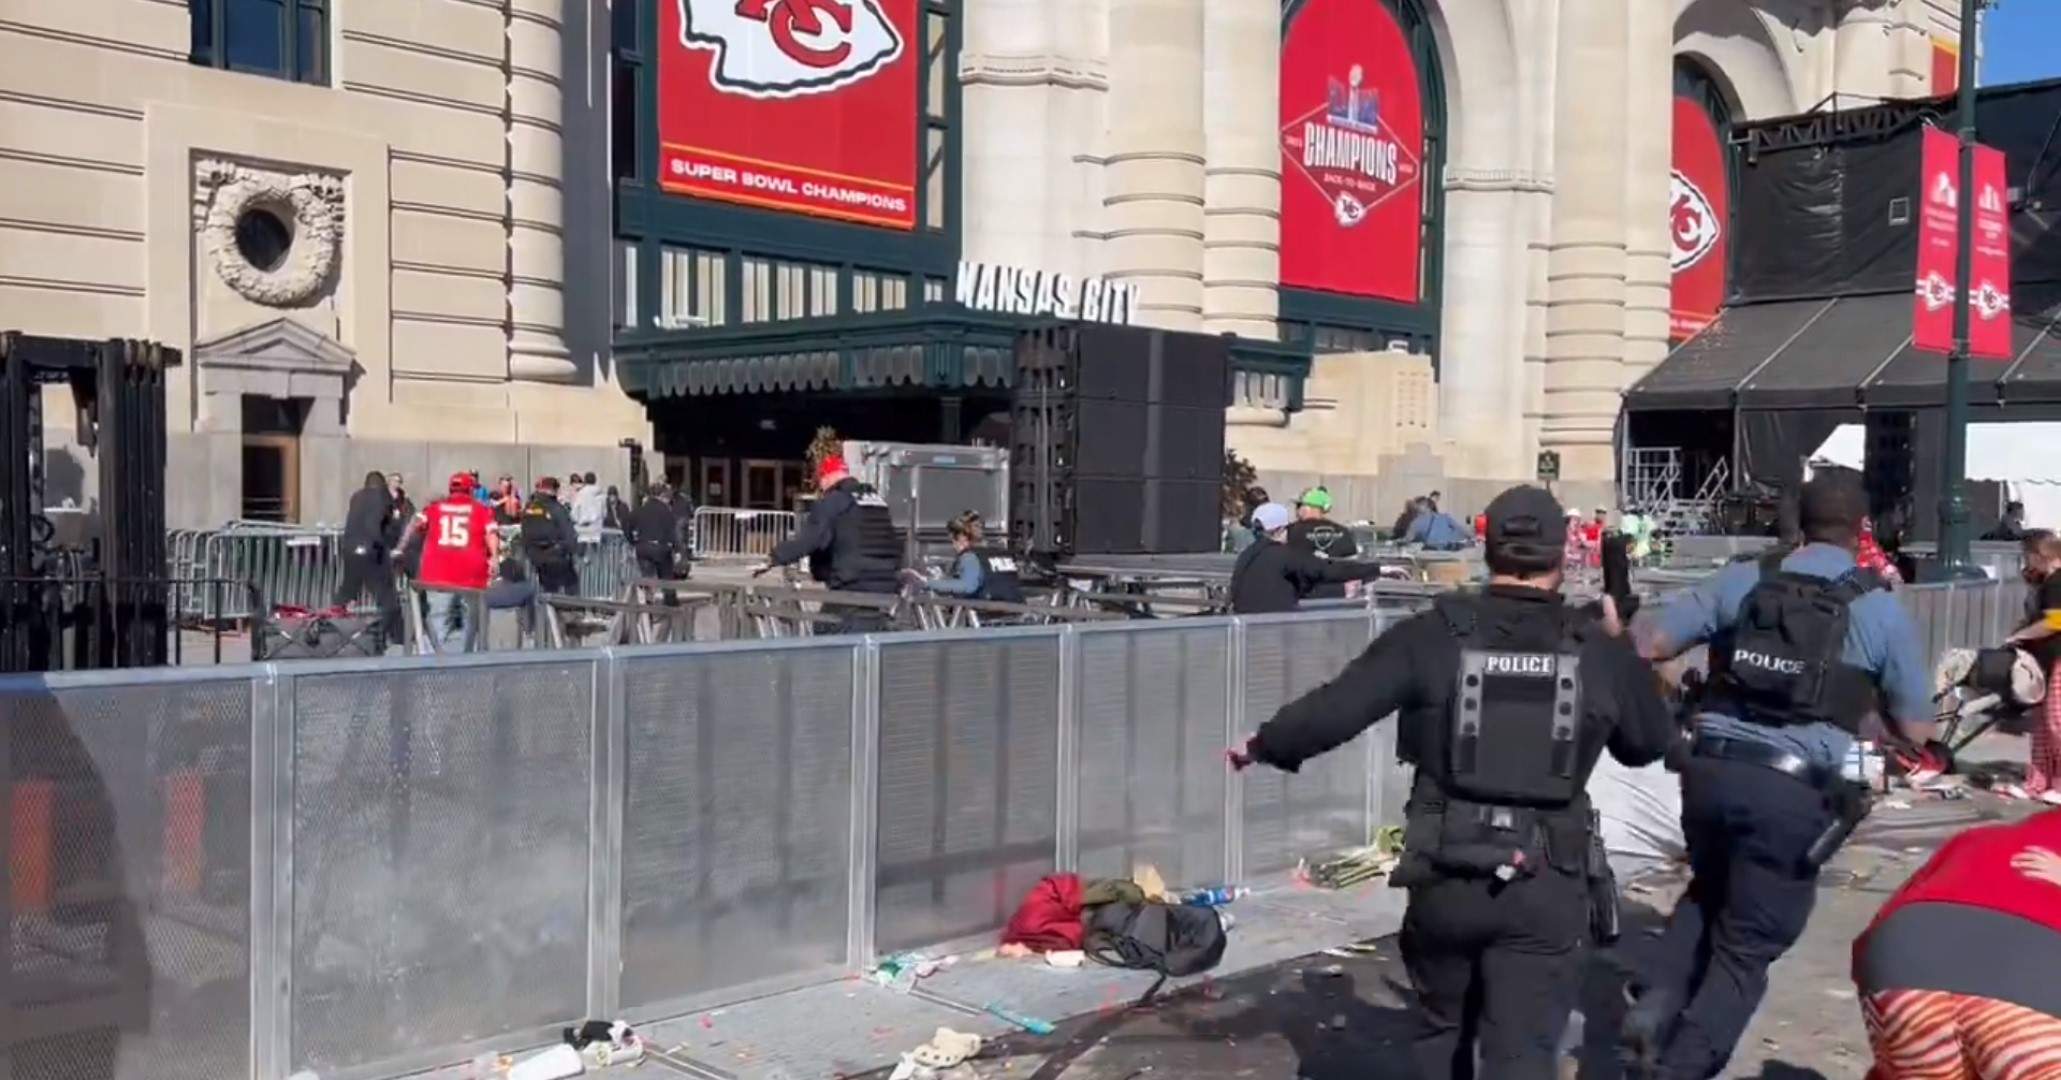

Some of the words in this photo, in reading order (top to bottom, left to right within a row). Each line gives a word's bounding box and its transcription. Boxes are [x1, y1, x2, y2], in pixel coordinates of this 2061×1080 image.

[1303, 122, 1397, 186] CHAMPIONS
[671, 158, 737, 183] SUPER
[742, 171, 798, 194] BOWL
[802, 183, 906, 212] CHAMPIONS
[956, 260, 1072, 319] KANSAS
[1083, 275, 1140, 325] CITY
[438, 514, 470, 547] 15
[1487, 656, 1553, 673] POLICE
[1733, 649, 1805, 674] POLICE
